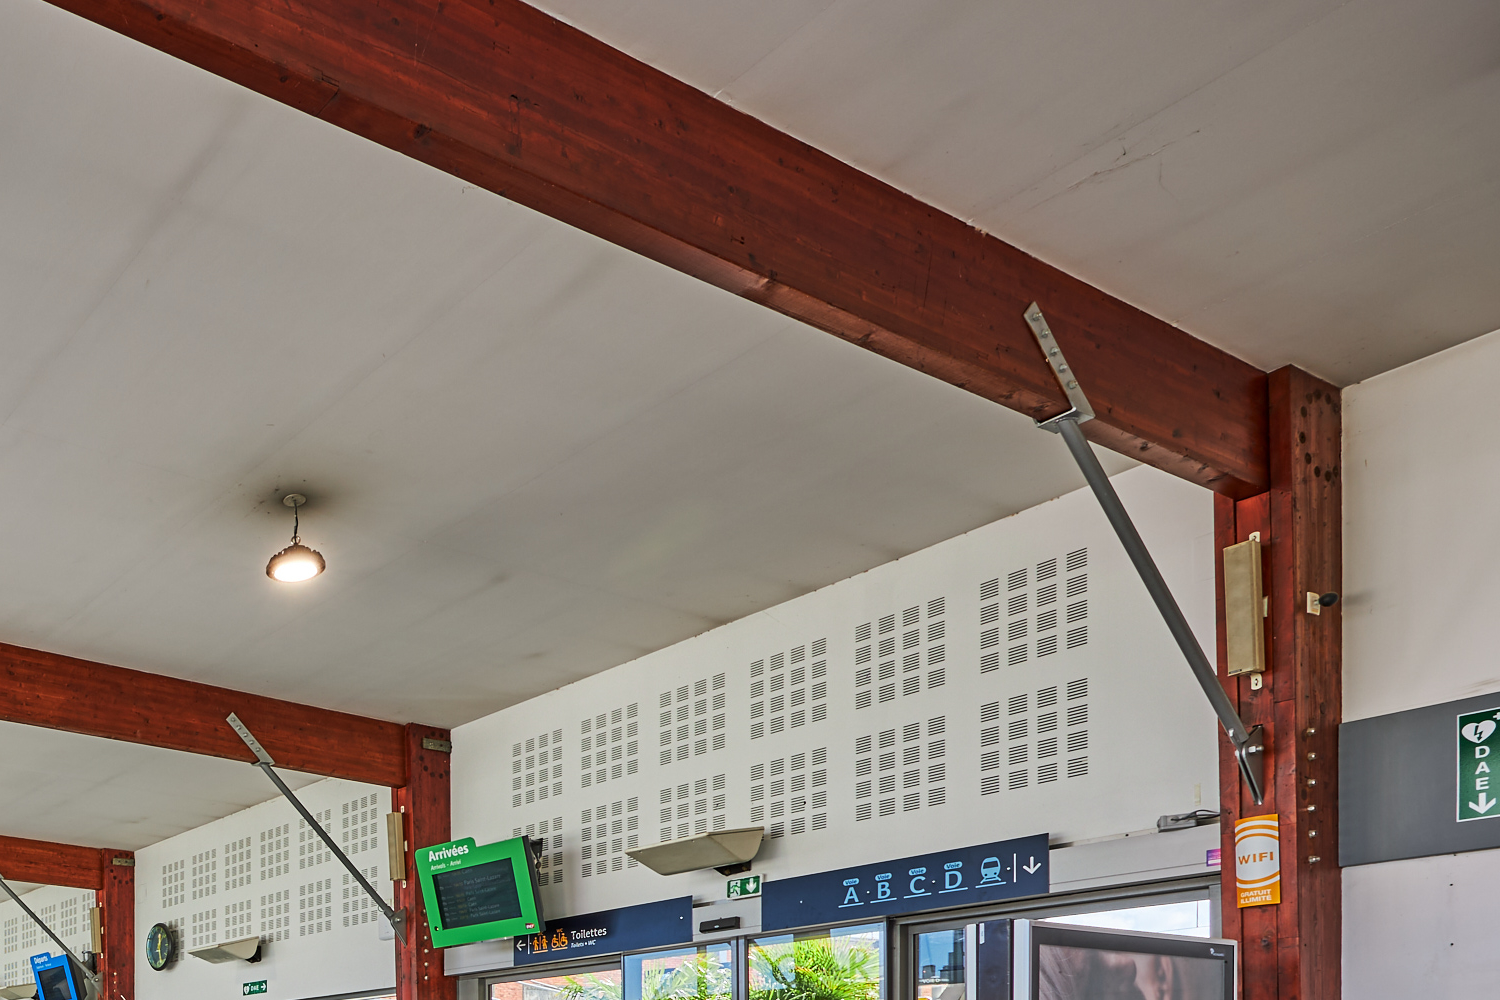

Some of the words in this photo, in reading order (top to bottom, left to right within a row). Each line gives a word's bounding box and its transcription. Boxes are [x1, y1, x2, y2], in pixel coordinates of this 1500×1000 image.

[1474, 745, 1491, 790] DAE
[428, 845, 469, 862] Arrivées
[1238, 851, 1274, 865] WIFI
[909, 876, 926, 894] C
[945, 870, 962, 889] D
[844, 886, 859, 904] A
[877, 882, 891, 899] B
[1240, 889, 1271, 898] GRATUIT
[571, 928, 607, 940] Toilettes
